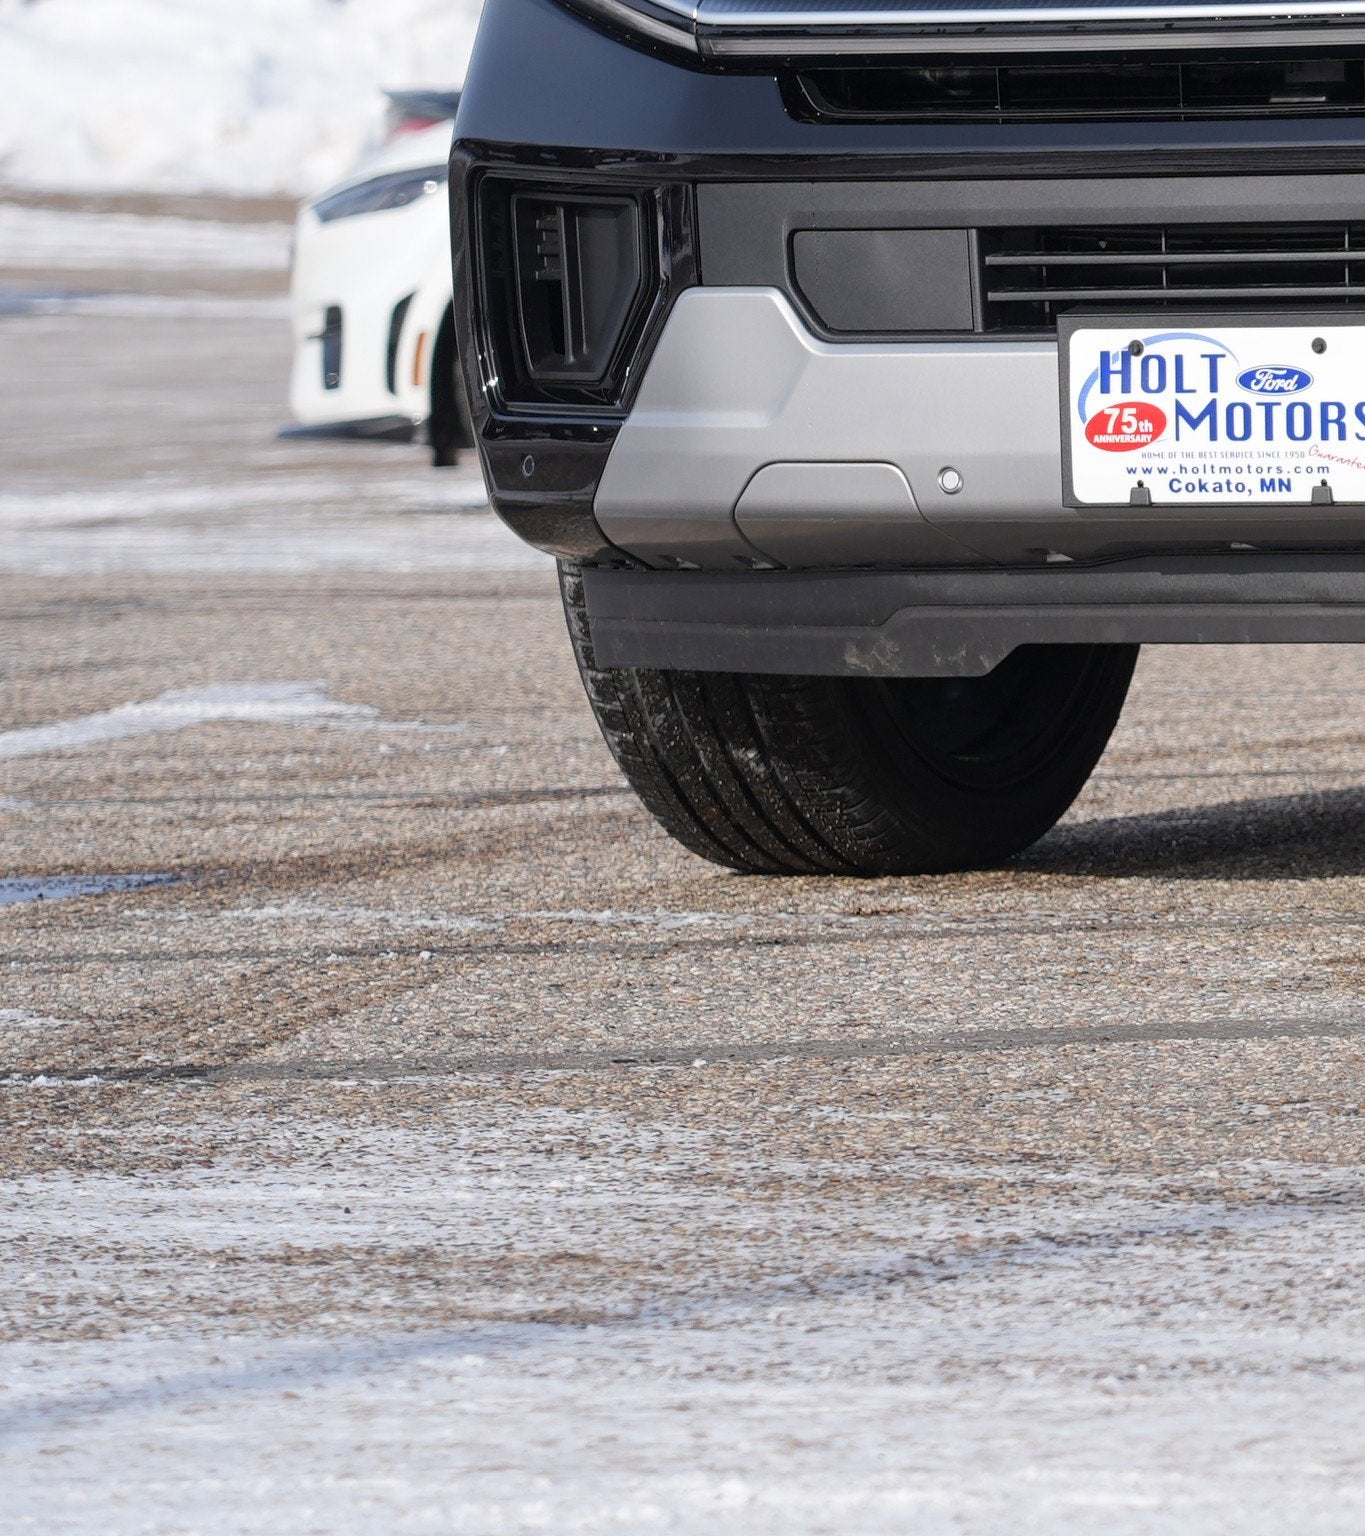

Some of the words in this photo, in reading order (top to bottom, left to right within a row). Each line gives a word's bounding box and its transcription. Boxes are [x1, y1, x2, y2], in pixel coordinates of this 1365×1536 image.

[1100, 350, 1227, 394] HOLT
[1250, 367, 1299, 392] Ford
[1103, 407, 1154, 434] 75th
[1093, 434, 1152, 444] ANNIVERSARY
[1141, 451, 1166, 459] HOME
[1168, 451, 1177, 459] OF
[1180, 451, 1195, 459] THE
[1199, 451, 1218, 459] BEST
[1220, 451, 1254, 459] SERVICE
[1257, 451, 1281, 459] SINCE
[1284, 451, 1305, 459] 1950
[1126, 464, 1330, 475] www.holtmotors.com
[1169, 478, 1252, 496] Cokato,
[1260, 478, 1292, 493] MN
